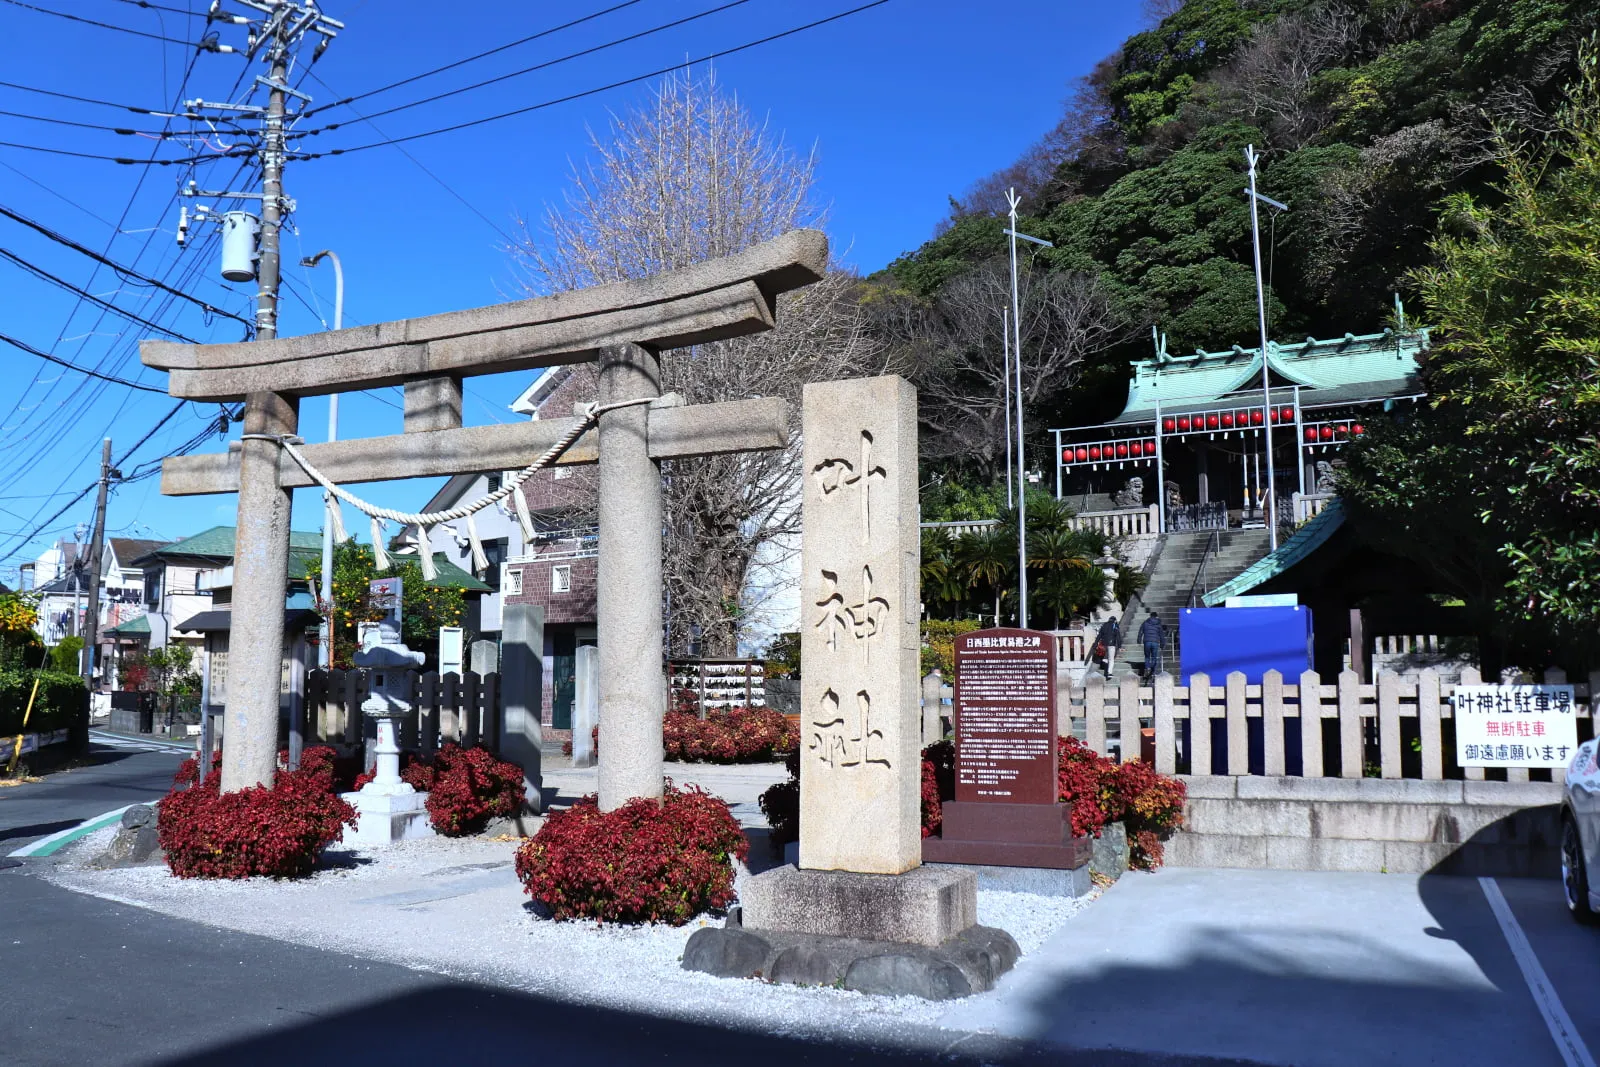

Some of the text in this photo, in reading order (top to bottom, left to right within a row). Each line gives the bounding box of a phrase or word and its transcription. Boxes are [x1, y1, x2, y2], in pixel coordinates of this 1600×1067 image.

[809, 429, 891, 769] 叶神社
[1458, 691, 1571, 714] 叶神社駐車場
[1486, 720, 1546, 737] 無断駐車
[1465, 744, 1571, 761] 御遠慮願います
